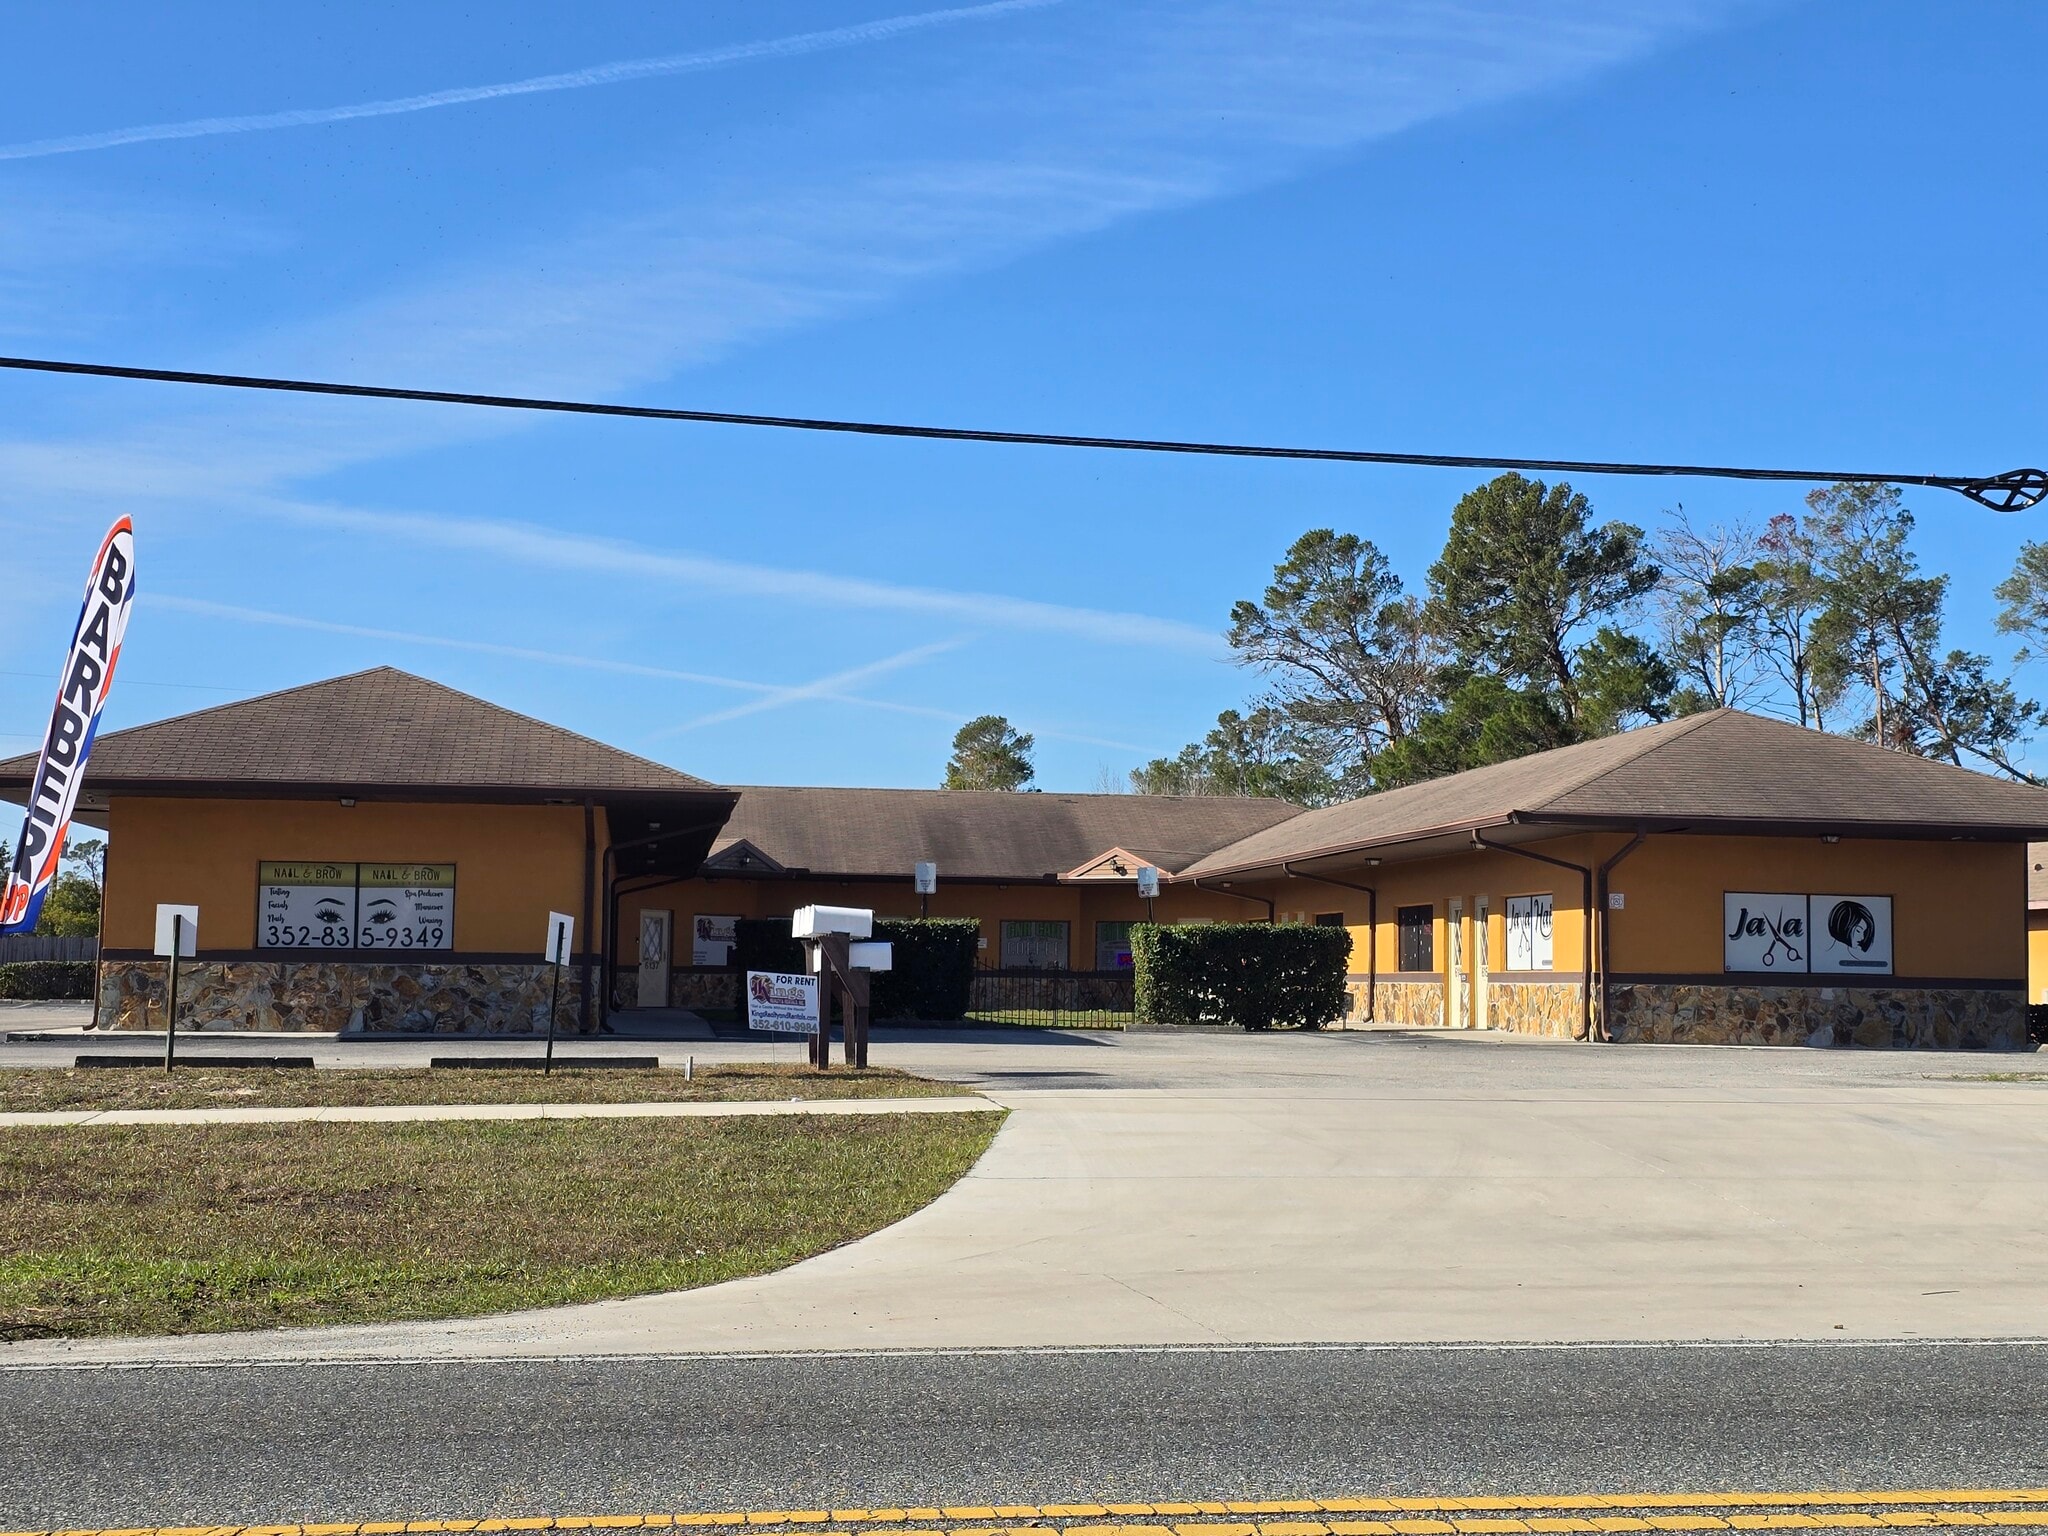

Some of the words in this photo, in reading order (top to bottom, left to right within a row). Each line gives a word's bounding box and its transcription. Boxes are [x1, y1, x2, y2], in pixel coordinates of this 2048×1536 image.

[20, 542, 127, 884] BARBER
[274, 868, 299, 878] NAIL
[303, 867, 312, 879] &
[316, 866, 342, 879] BROW
[372, 870, 398, 880] NAIL
[401, 869, 411, 880] &
[414, 868, 440, 881] BROW
[418, 916, 443, 927] Waxing
[776, 975, 792, 985] FOR
[795, 977, 816, 987] RENT
[751, 975, 805, 1002] Kings
